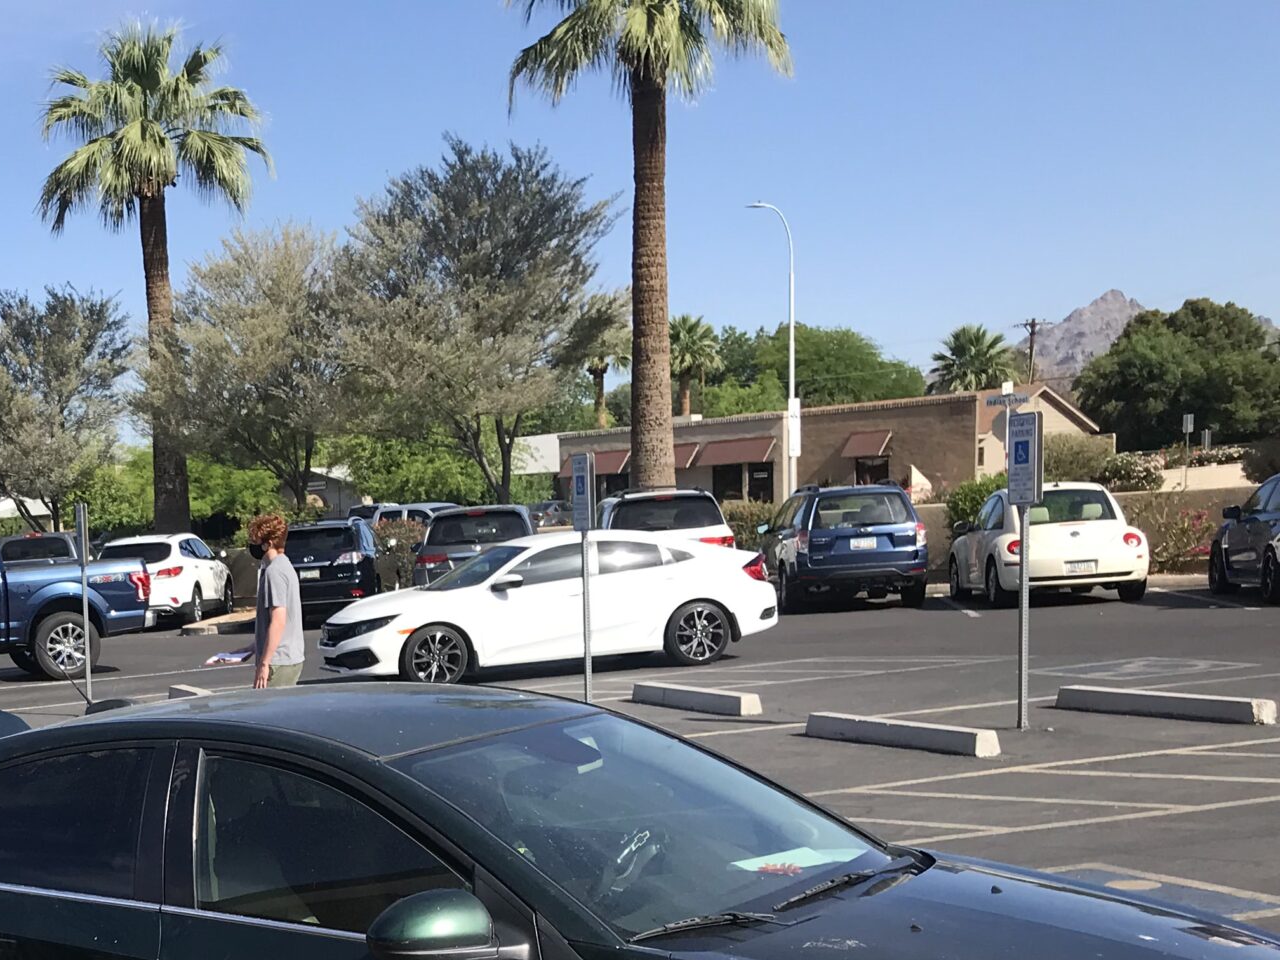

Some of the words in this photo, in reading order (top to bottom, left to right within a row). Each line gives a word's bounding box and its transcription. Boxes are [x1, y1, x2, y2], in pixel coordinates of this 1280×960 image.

[986, 398, 1006, 406] Indian
[1008, 395, 1028, 405] School
[1011, 428, 1033, 438] PARKING
